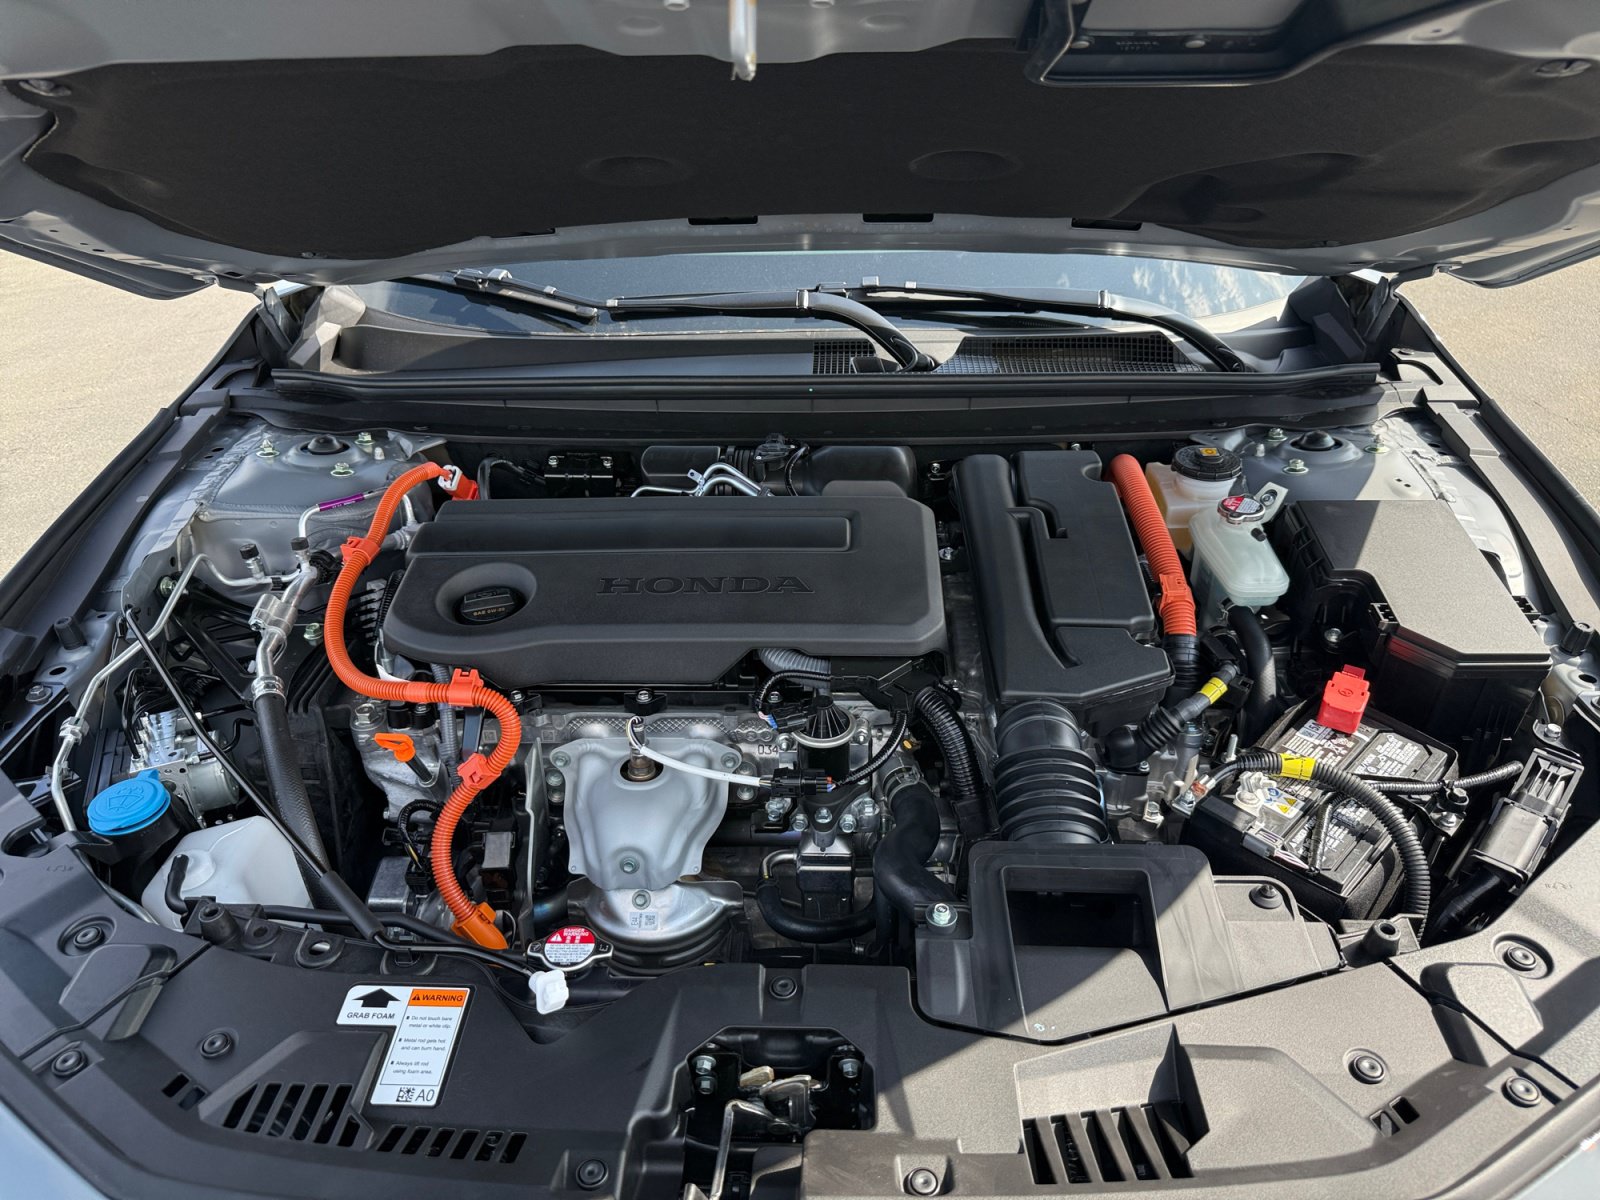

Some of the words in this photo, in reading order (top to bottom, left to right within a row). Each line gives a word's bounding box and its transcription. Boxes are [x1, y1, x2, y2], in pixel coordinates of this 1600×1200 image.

[597, 576, 814, 594] HONDA
[422, 994, 463, 1002] WARNING
[372, 1012, 395, 1020] FOAM
[415, 1088, 435, 1102] A0
